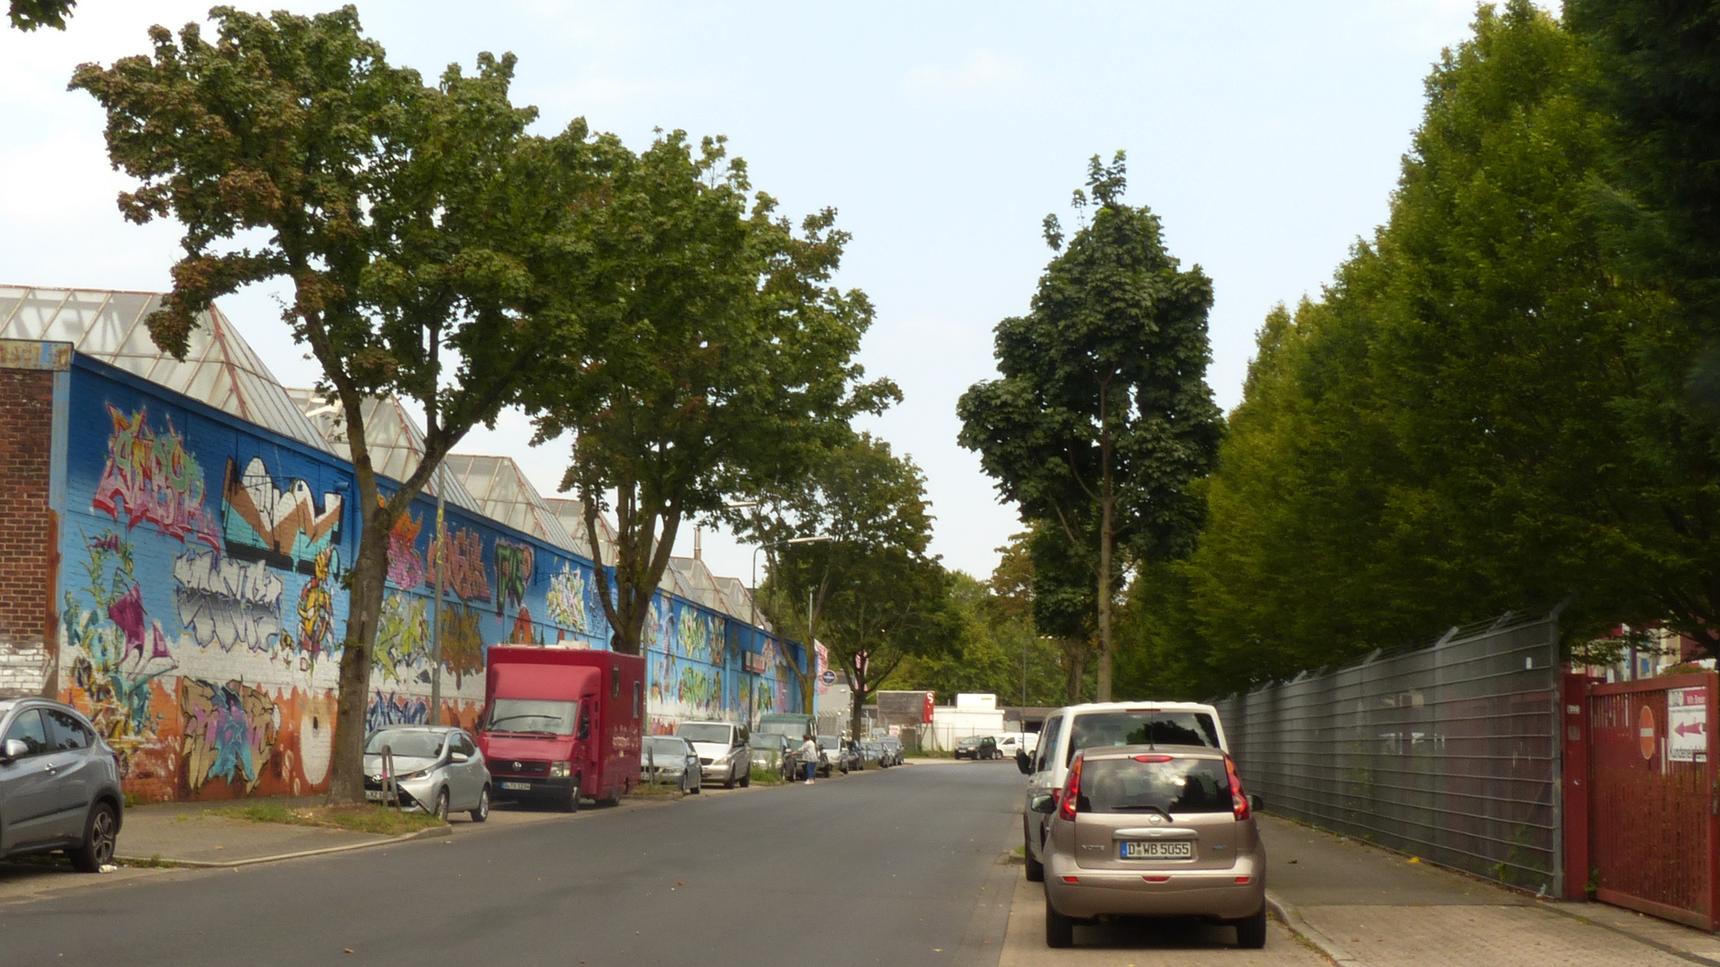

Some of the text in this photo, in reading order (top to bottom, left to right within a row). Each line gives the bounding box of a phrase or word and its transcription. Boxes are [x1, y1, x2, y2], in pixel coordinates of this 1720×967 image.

[1128, 843, 1189, 855] D WB 5055
